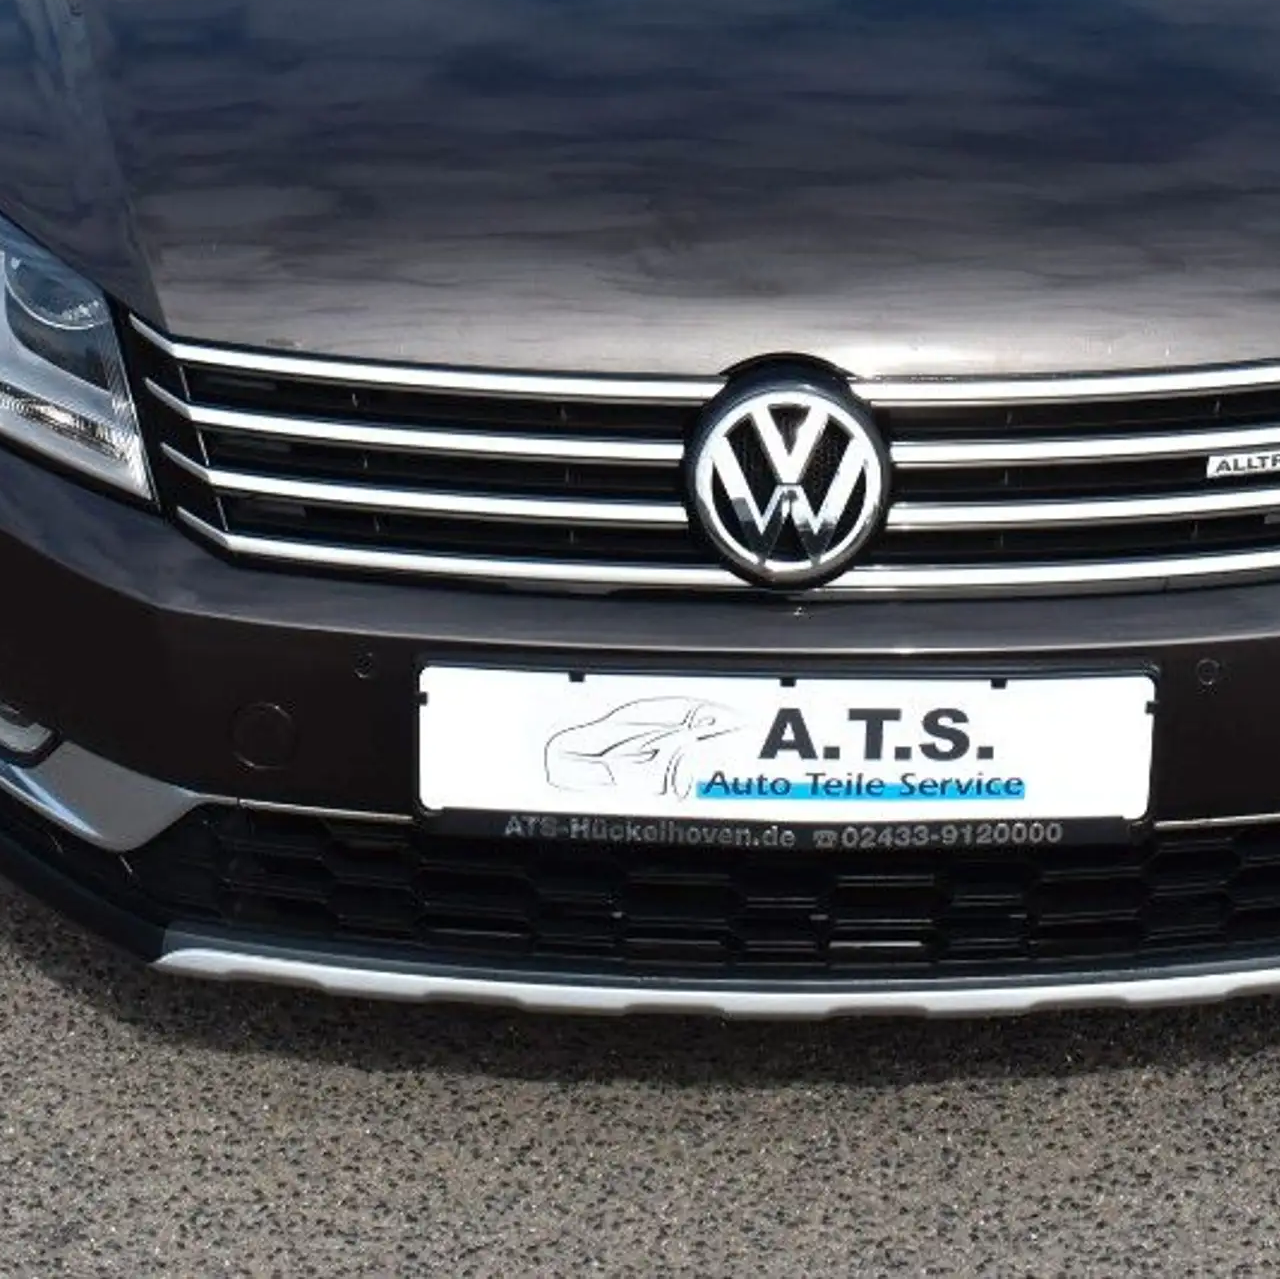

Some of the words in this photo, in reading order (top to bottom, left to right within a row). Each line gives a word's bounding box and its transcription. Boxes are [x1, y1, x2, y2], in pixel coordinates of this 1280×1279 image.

[758, 707, 995, 762] A.T.S.
[703, 770, 792, 797] Auto
[806, 770, 885, 797] Teile
[900, 770, 1026, 797] Service
[504, 815, 797, 848] ATS-Hückelhoven.de
[840, 821, 1064, 849] 02433-9120000
